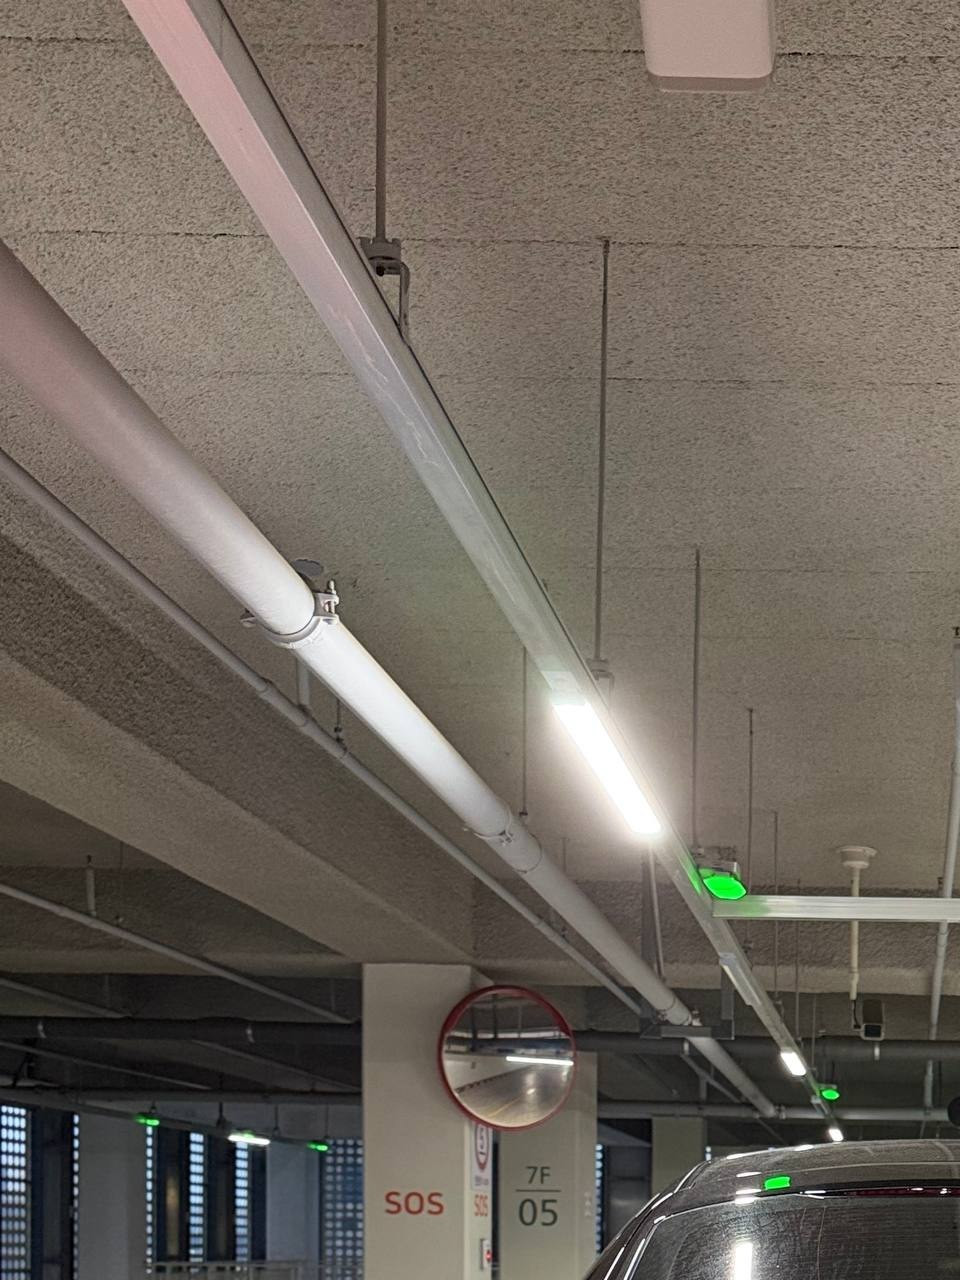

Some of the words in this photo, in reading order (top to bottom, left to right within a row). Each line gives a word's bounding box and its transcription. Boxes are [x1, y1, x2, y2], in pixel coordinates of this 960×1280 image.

[526, 1166, 551, 1185] 7F
[385, 1191, 444, 1216] SOS
[474, 1194, 488, 1217] SOS
[518, 1198, 558, 1227] 05
